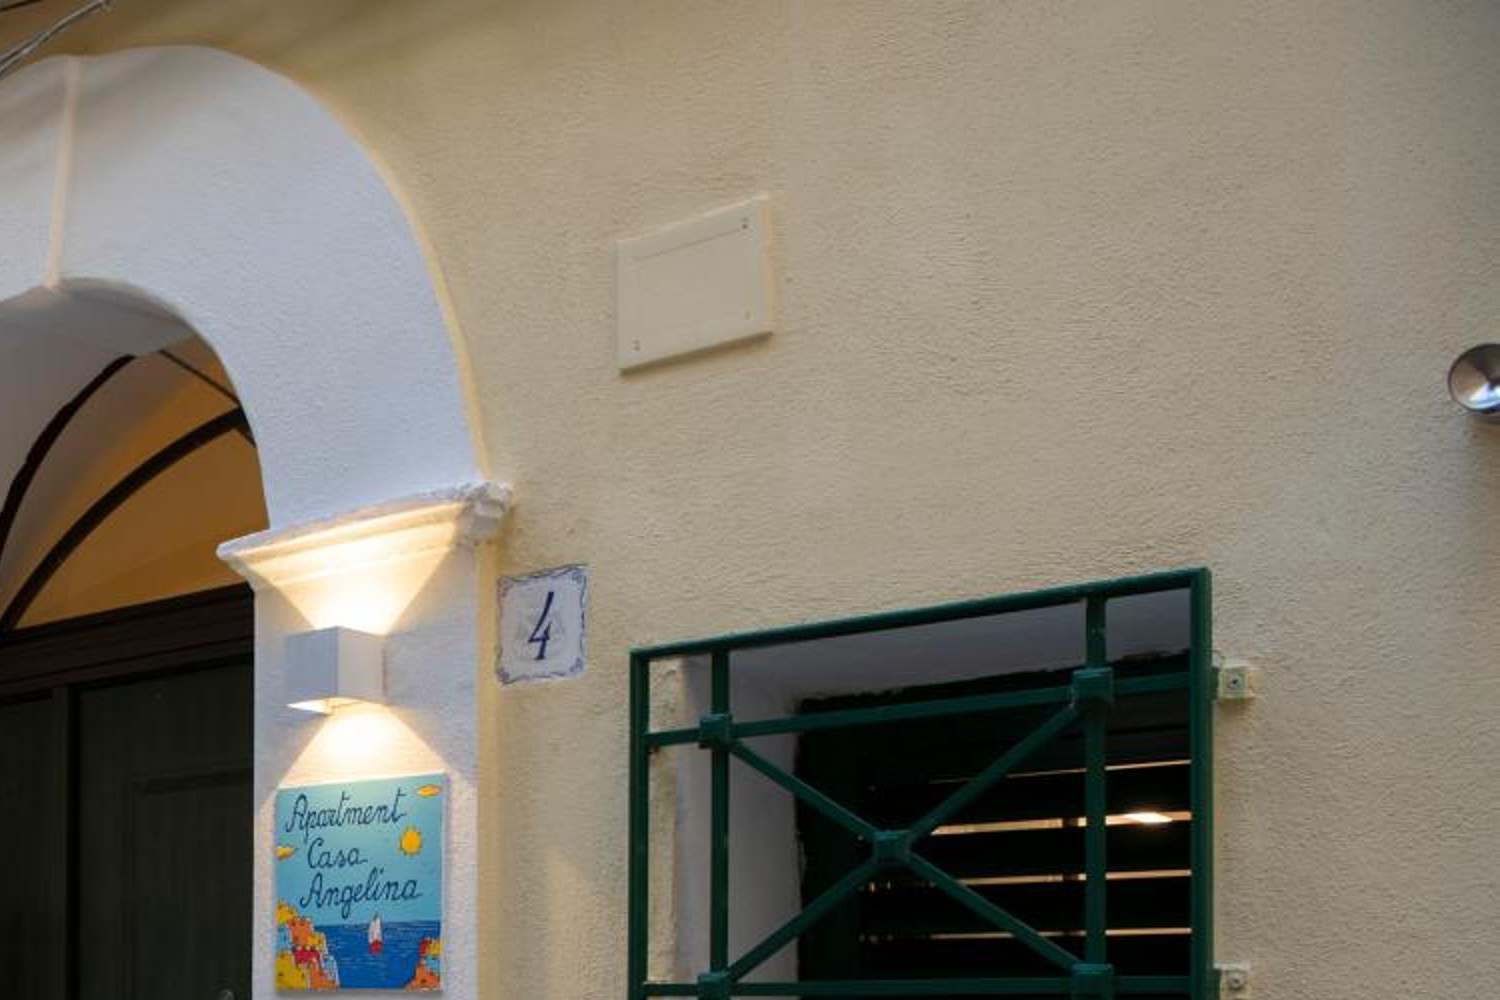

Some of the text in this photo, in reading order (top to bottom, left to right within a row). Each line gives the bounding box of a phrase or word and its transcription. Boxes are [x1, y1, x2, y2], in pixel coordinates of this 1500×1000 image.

[528, 592, 554, 660] 4
[286, 787, 406, 843] Apartment
[307, 837, 368, 869] Casa
[300, 866, 422, 919] Angelina
